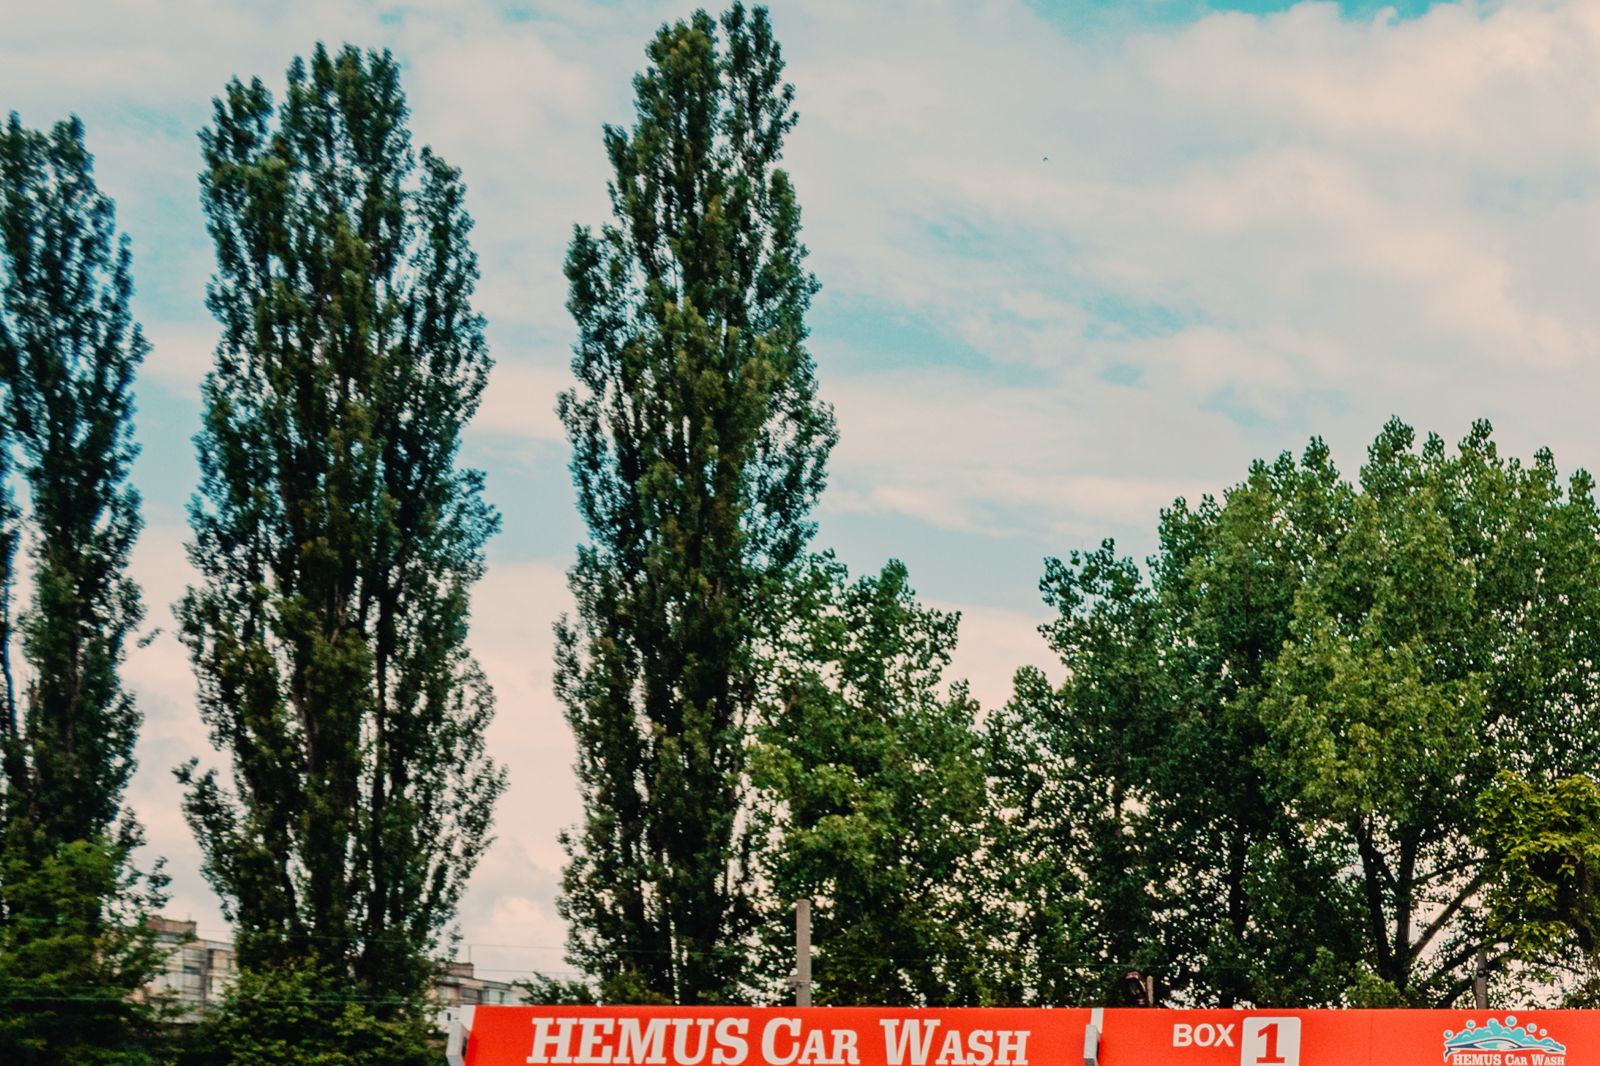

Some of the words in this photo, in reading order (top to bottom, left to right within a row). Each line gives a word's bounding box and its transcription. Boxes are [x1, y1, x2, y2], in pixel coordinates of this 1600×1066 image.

[526, 1016, 750, 1066] HEMUS
[1172, 1023, 1235, 1048] BOX
[1256, 1023, 1286, 1064] 1
[1452, 1054, 1502, 1066] HEMUS
